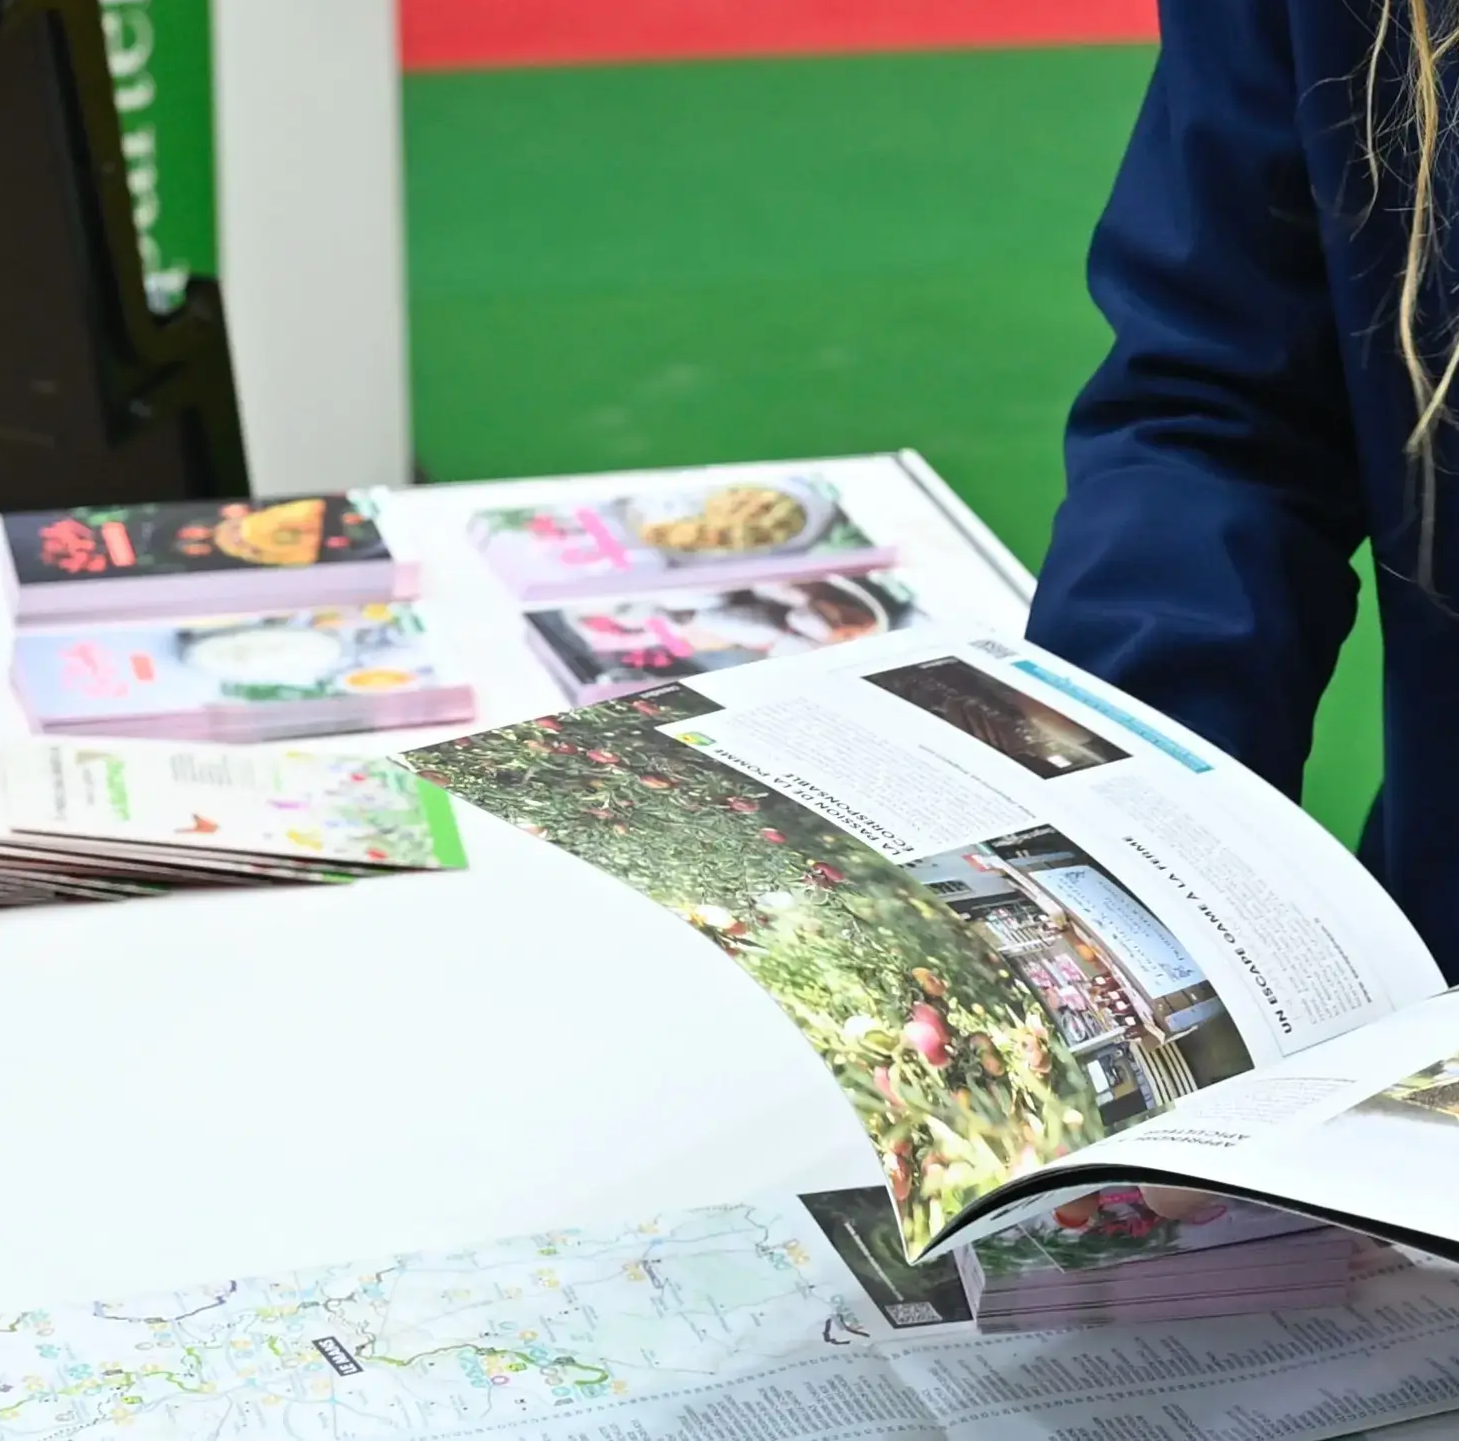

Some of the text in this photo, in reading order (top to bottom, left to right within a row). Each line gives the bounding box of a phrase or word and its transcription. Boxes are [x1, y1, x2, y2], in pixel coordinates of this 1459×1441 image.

[815, 801, 880, 842] PASSION
[1167, 873, 1187, 889] LA
[1197, 903, 1236, 945] GAME
[1235, 947, 1278, 1006] ESCAPE
[1275, 1009, 1293, 1035] UN
